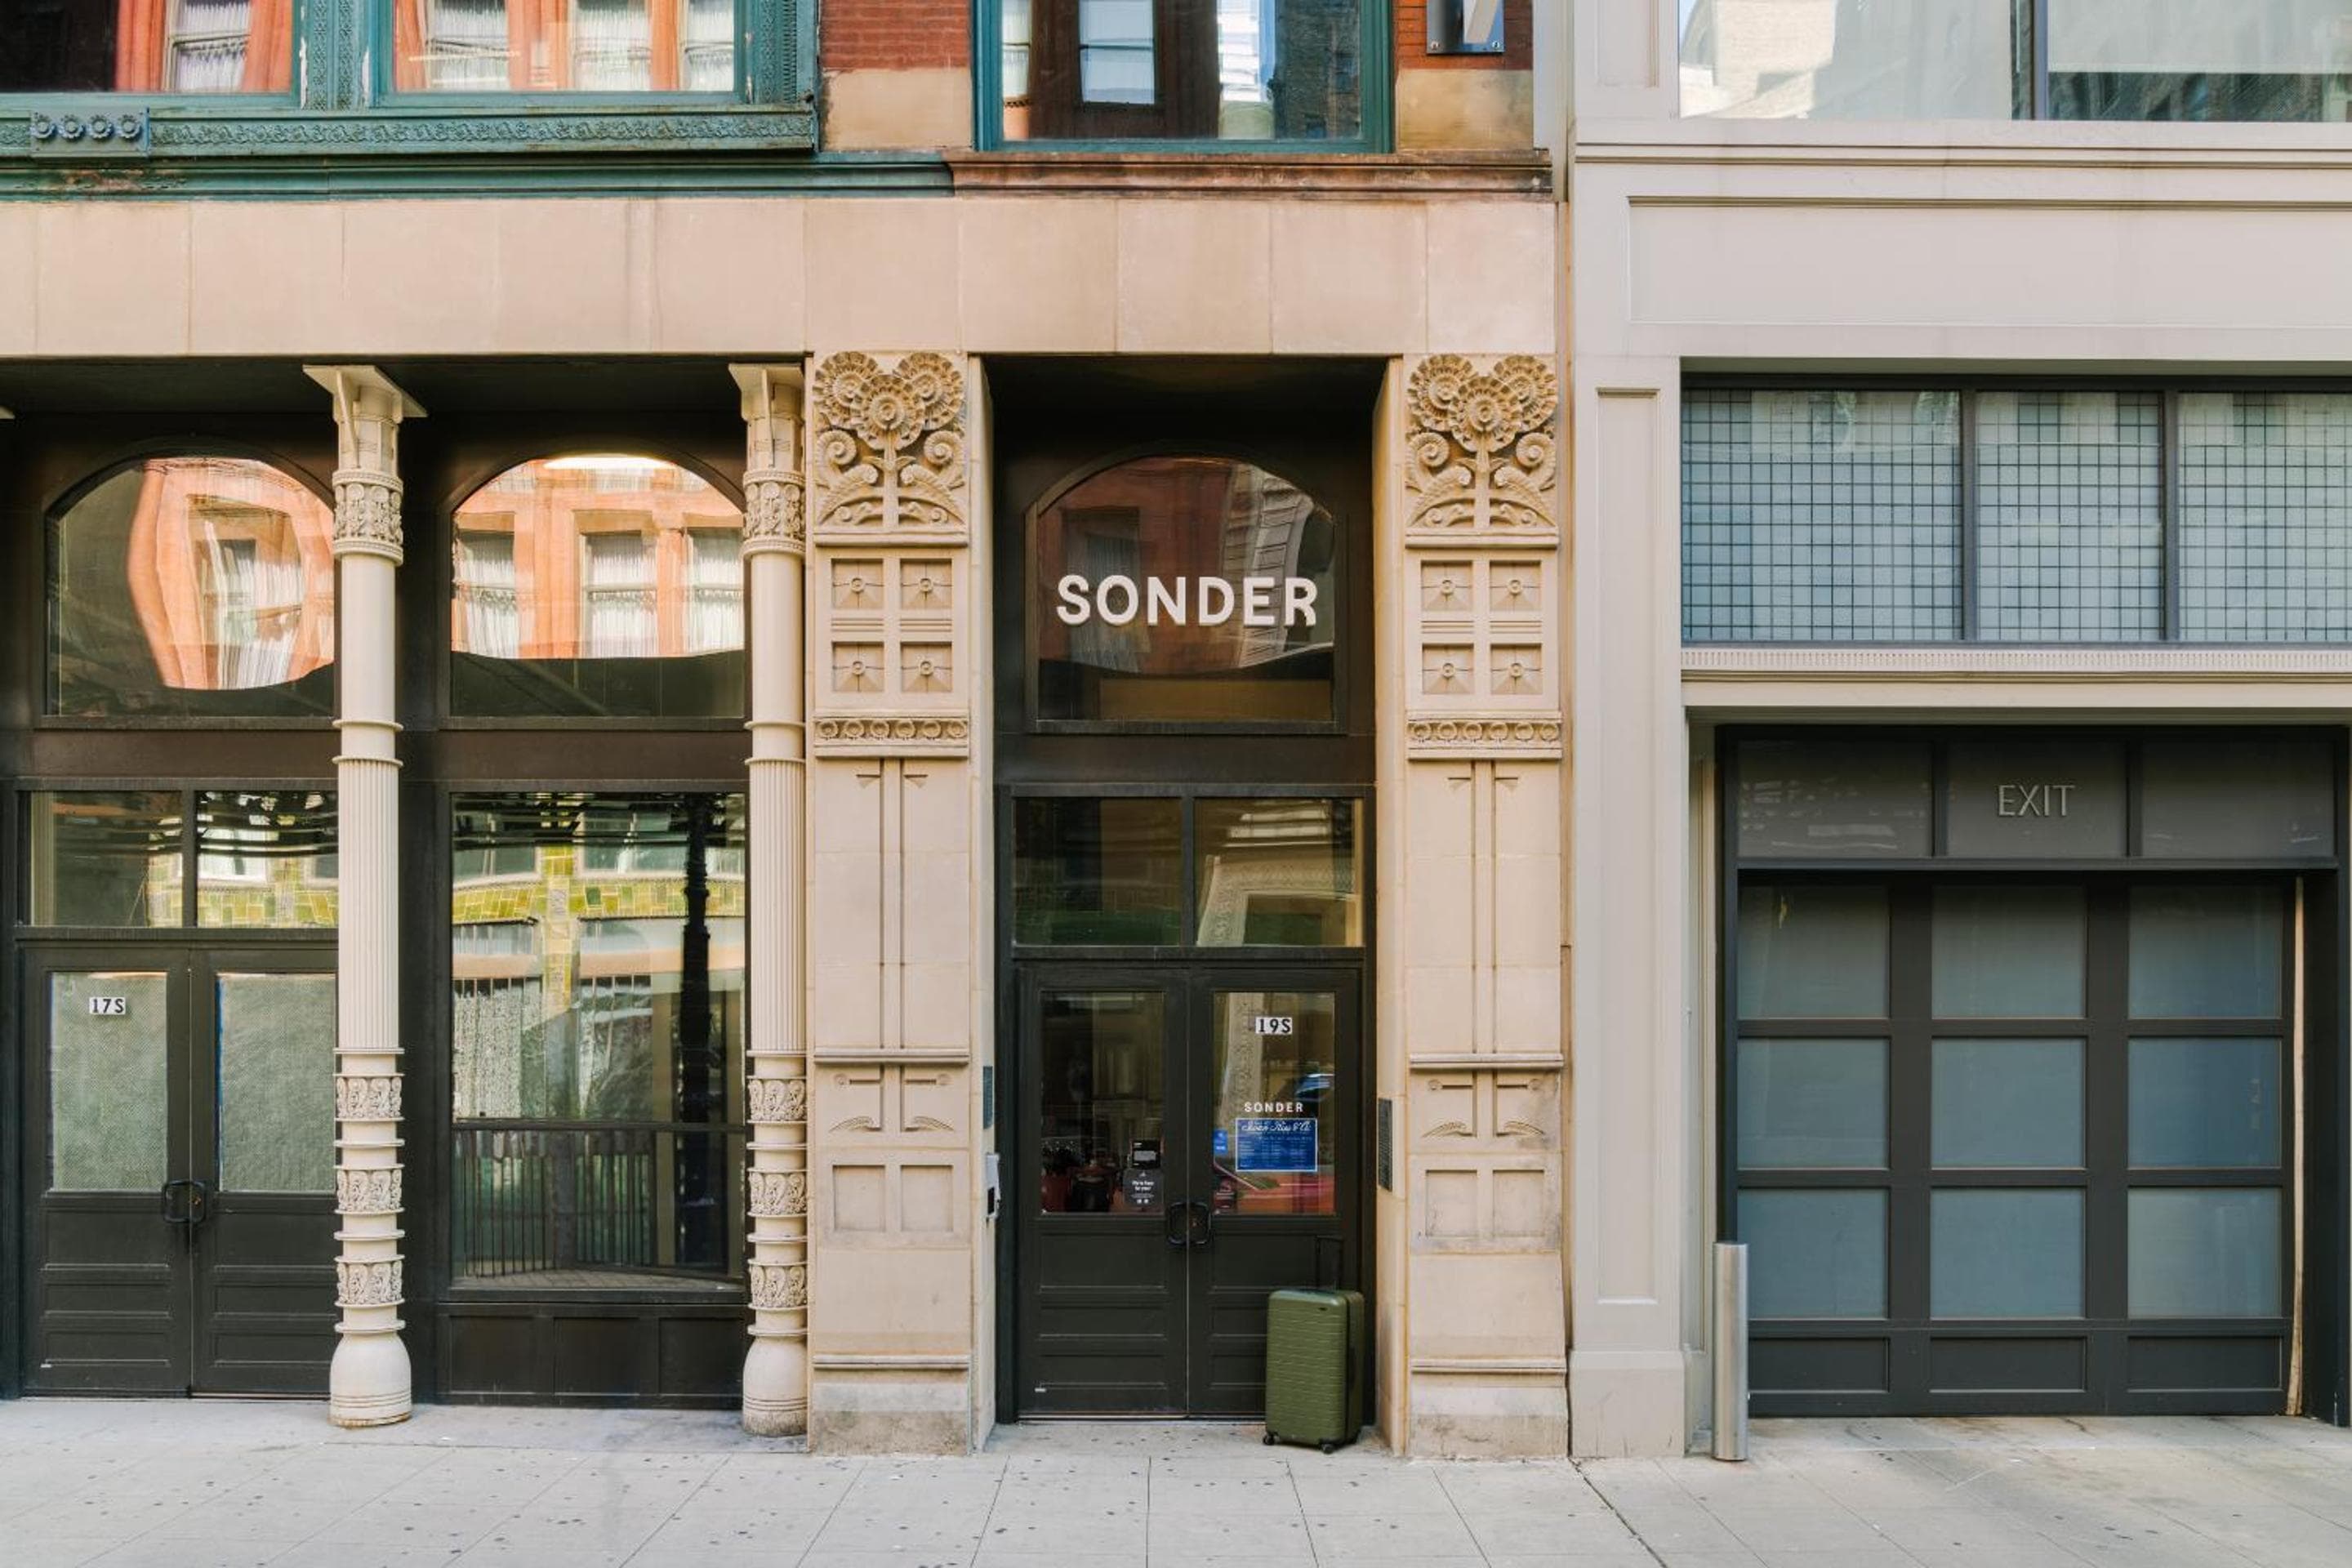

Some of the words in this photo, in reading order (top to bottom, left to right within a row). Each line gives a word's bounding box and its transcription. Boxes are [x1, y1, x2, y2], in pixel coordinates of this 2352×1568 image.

[1056, 574, 1318, 626] SONDER
[1998, 785, 2075, 816] EXIT
[92, 998, 124, 1013] 17S
[1258, 1018, 1291, 1034] 19S
[1244, 1102, 1303, 1112] SONDER
